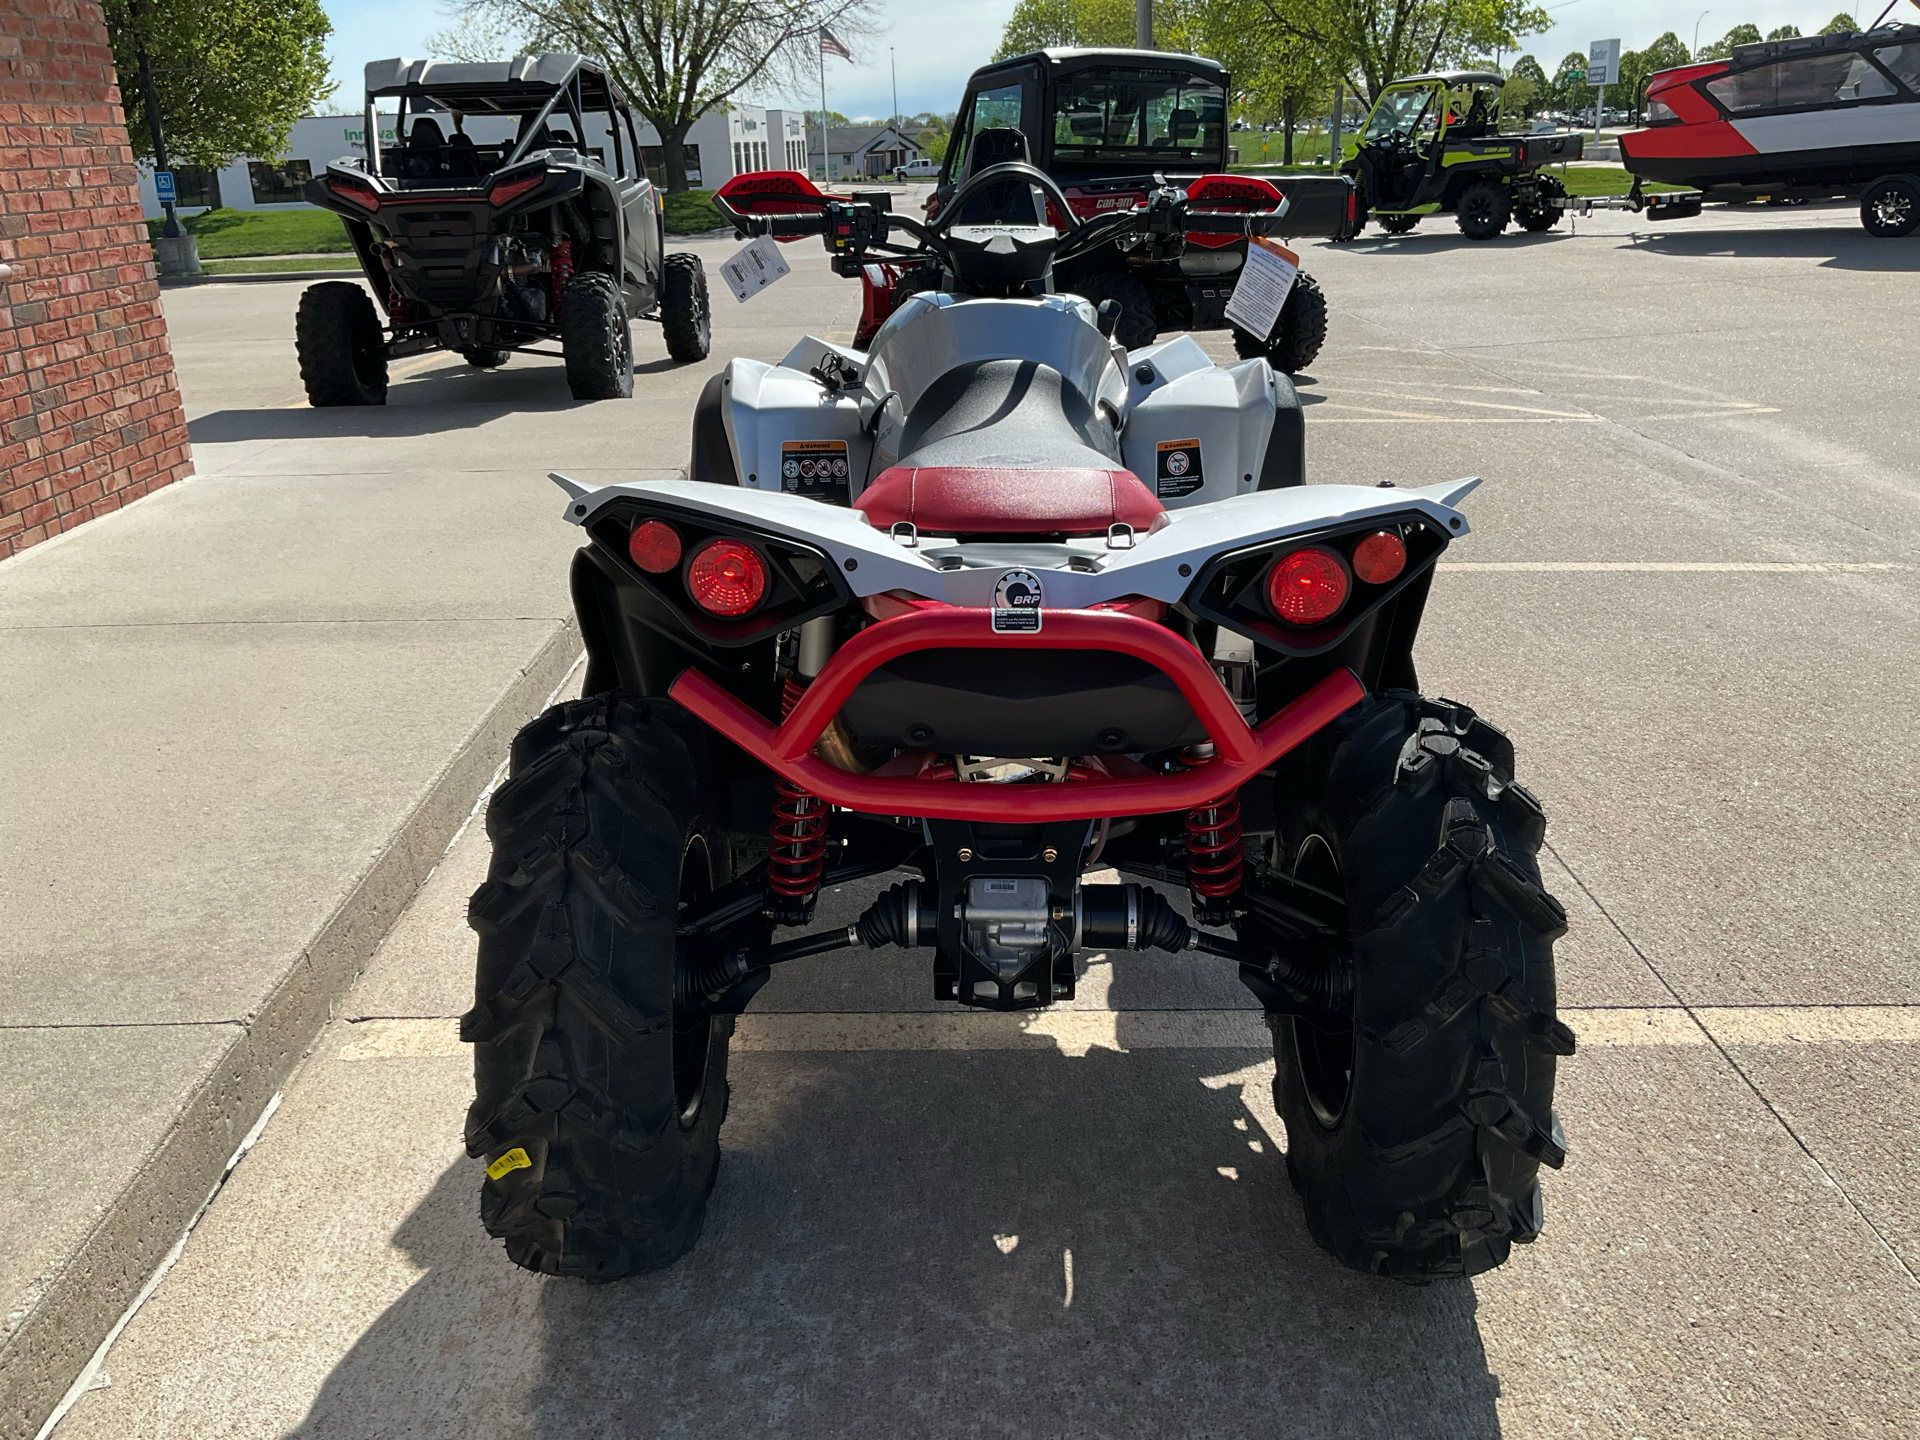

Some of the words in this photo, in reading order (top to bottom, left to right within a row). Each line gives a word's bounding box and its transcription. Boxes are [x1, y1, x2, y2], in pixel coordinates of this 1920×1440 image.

[1590, 49, 1607, 61] Baxter
[1096, 198, 1134, 208] can-am
[1014, 595, 1040, 604] BRP
